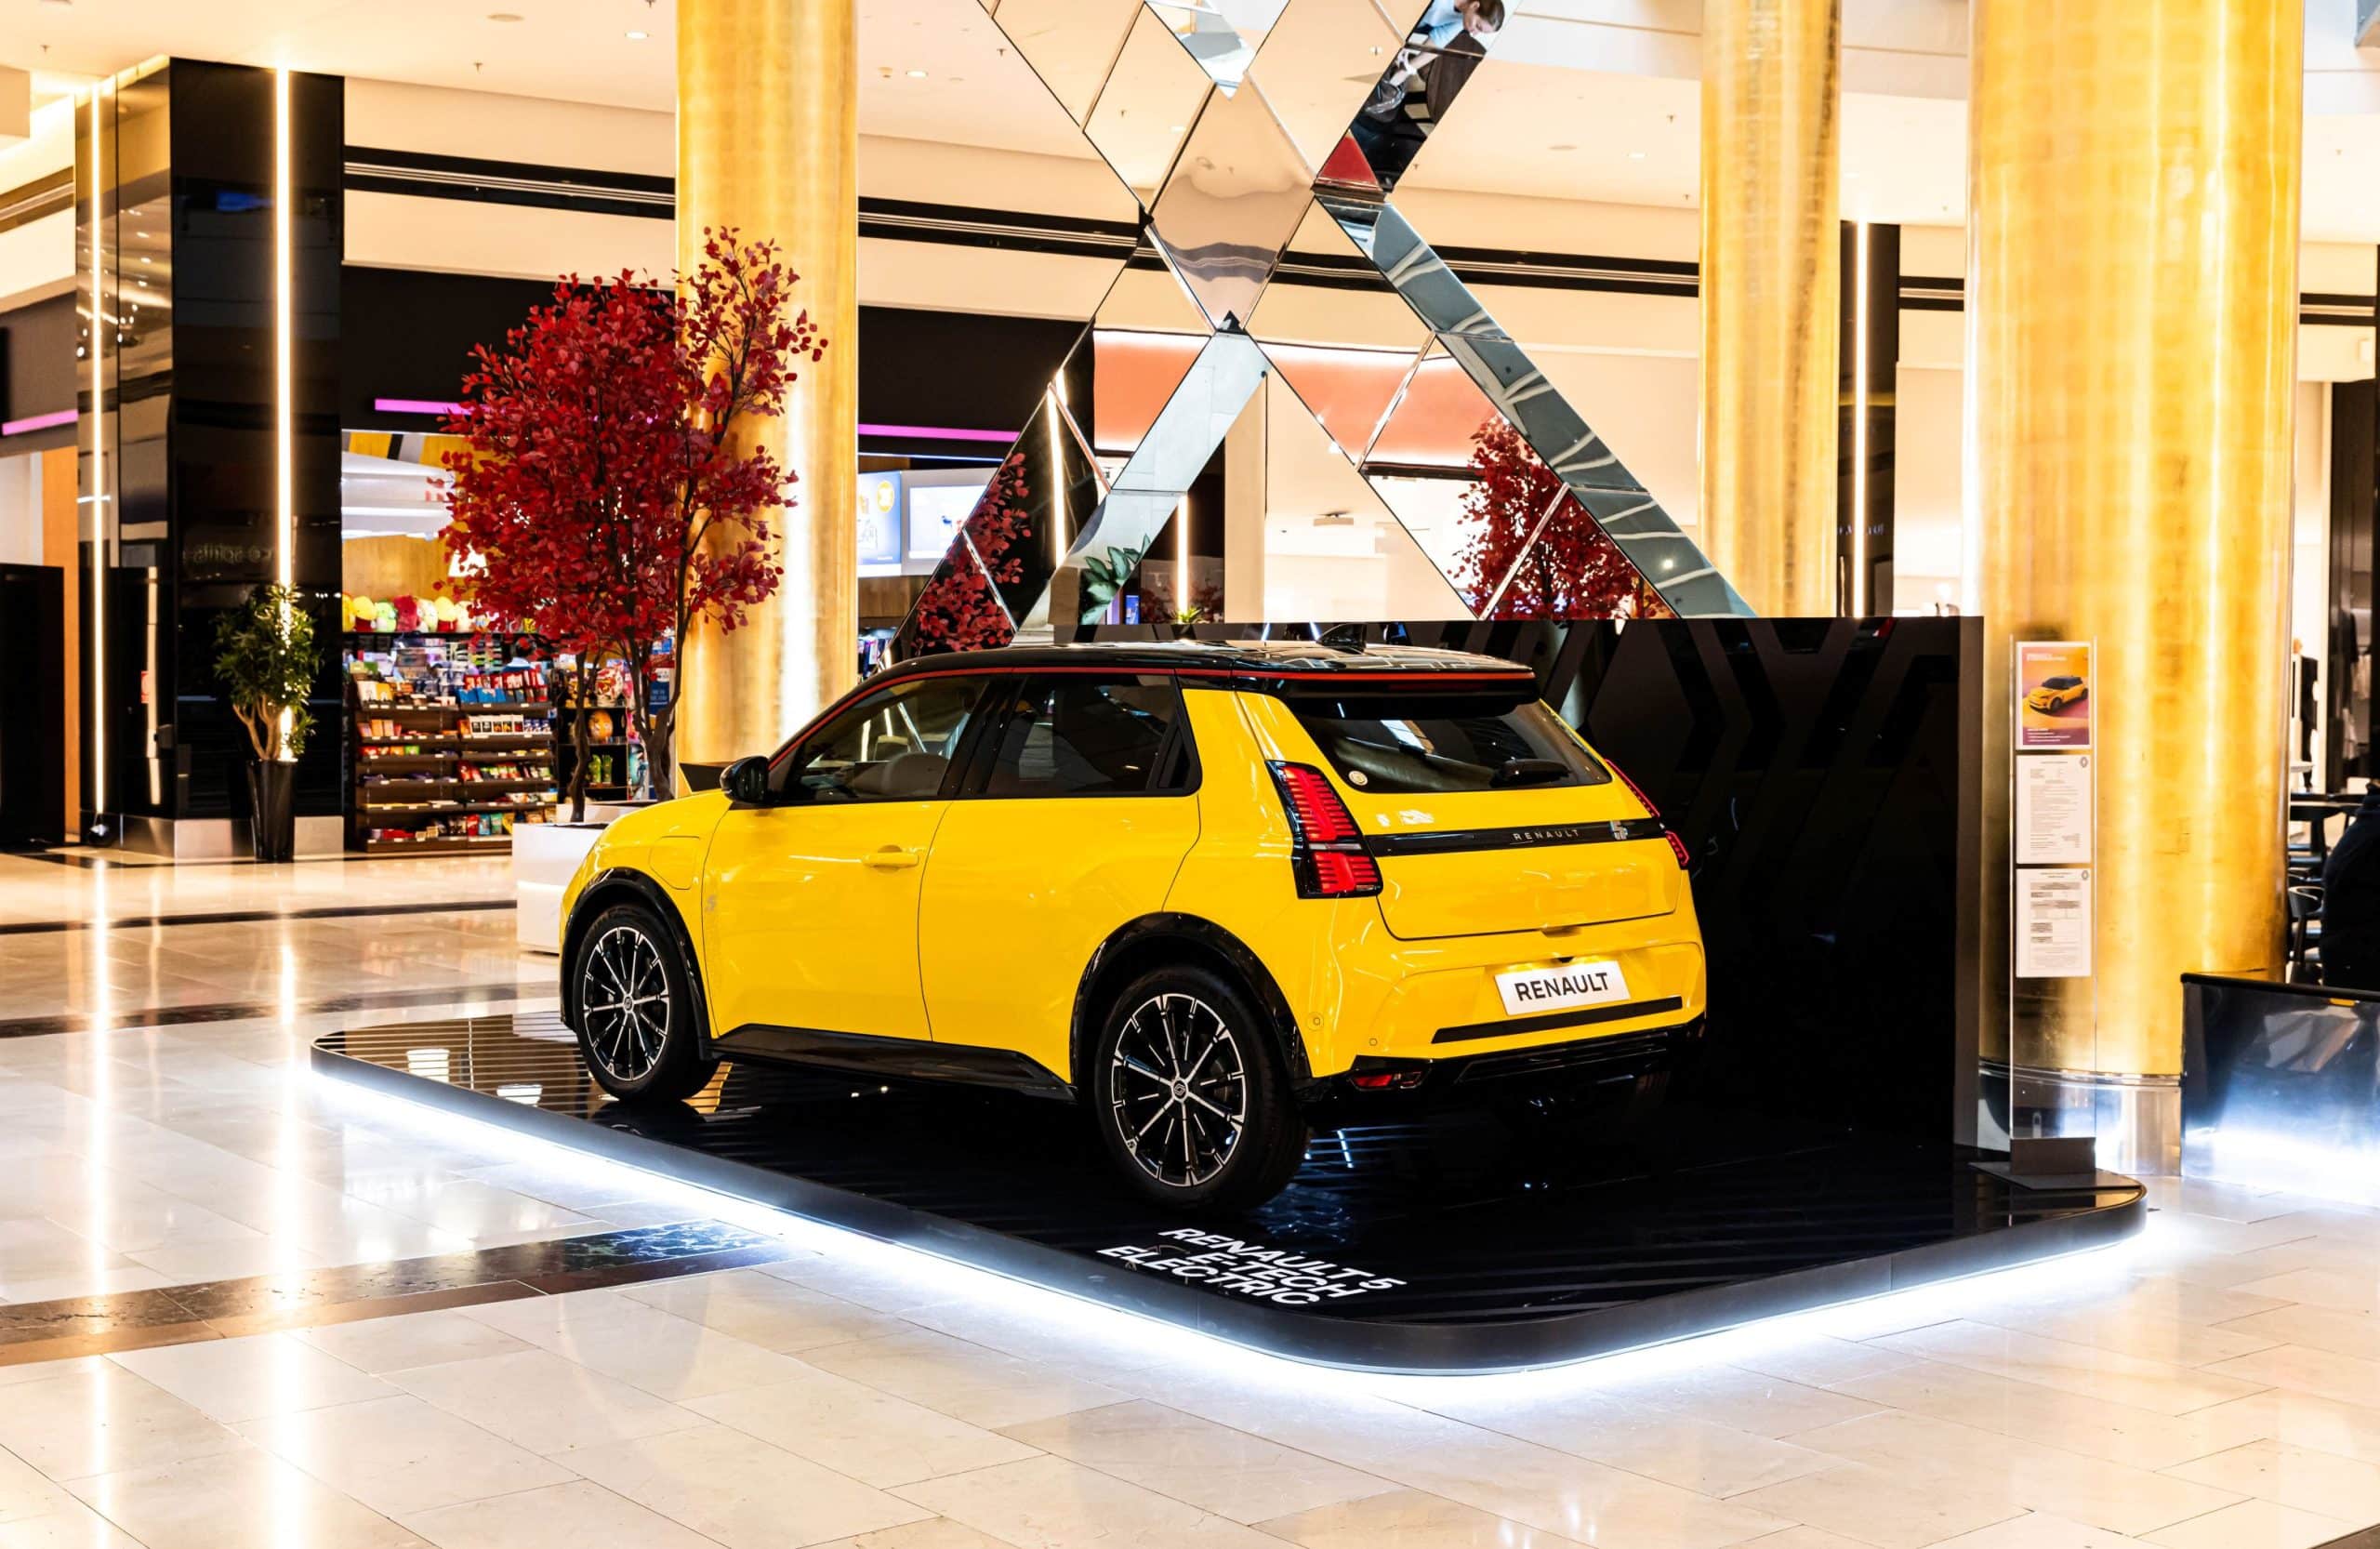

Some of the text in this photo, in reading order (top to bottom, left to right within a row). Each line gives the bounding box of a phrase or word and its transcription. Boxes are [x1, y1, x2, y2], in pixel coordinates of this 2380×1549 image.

[1512, 828, 1579, 841] RENAULT
[1514, 973, 1608, 1001] RENAULT
[1095, 1245, 1320, 1304] ELECTRIC
[1157, 1227, 1408, 1290] RENAULT 5
[1185, 1251, 1368, 1298] E-TECH
